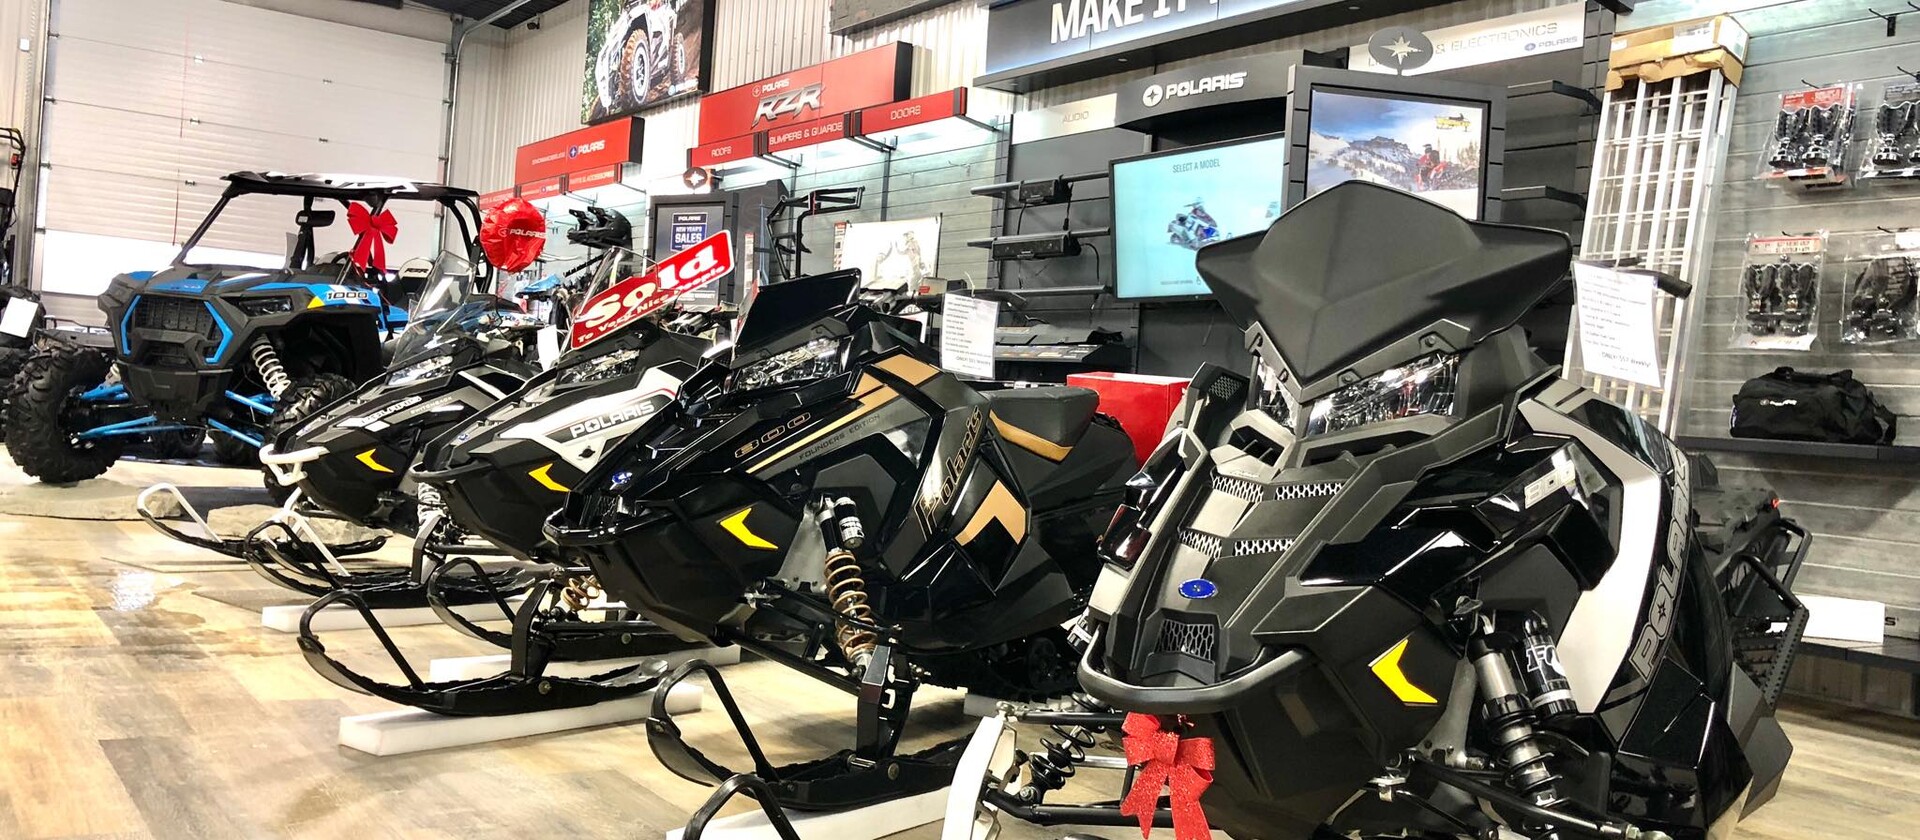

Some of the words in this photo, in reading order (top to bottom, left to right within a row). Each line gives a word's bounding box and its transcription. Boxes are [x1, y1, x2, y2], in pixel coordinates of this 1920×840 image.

[1050, 0, 1144, 44] MAKE
[1450, 22, 1558, 51] ELECTRONICS
[1538, 36, 1578, 48] POLARIS
[761, 78, 791, 94] POLARIS
[1165, 72, 1248, 100] POLARIS
[751, 82, 827, 130] RZR
[890, 105, 921, 121] DOORS
[1062, 110, 1090, 123] AUDIO
[768, 128, 802, 146] BUMPERS
[803, 127, 810, 138] &
[811, 122, 843, 137] GUARDS
[577, 139, 606, 155] POLARIS
[711, 145, 732, 158] ROOFS
[1172, 163, 1193, 173] SELECT
[1194, 162, 1199, 170] A
[1200, 158, 1221, 169] MODEL
[675, 233, 702, 244] SALES
[326, 291, 368, 301] 1000
[580, 245, 718, 328] Sold
[577, 332, 594, 343] To
[637, 293, 669, 314] Nice
[569, 400, 655, 438] POLARIS
[799, 432, 845, 460] FOUNDERS
[848, 414, 880, 434] EDITION
[914, 405, 982, 542] Polaris
